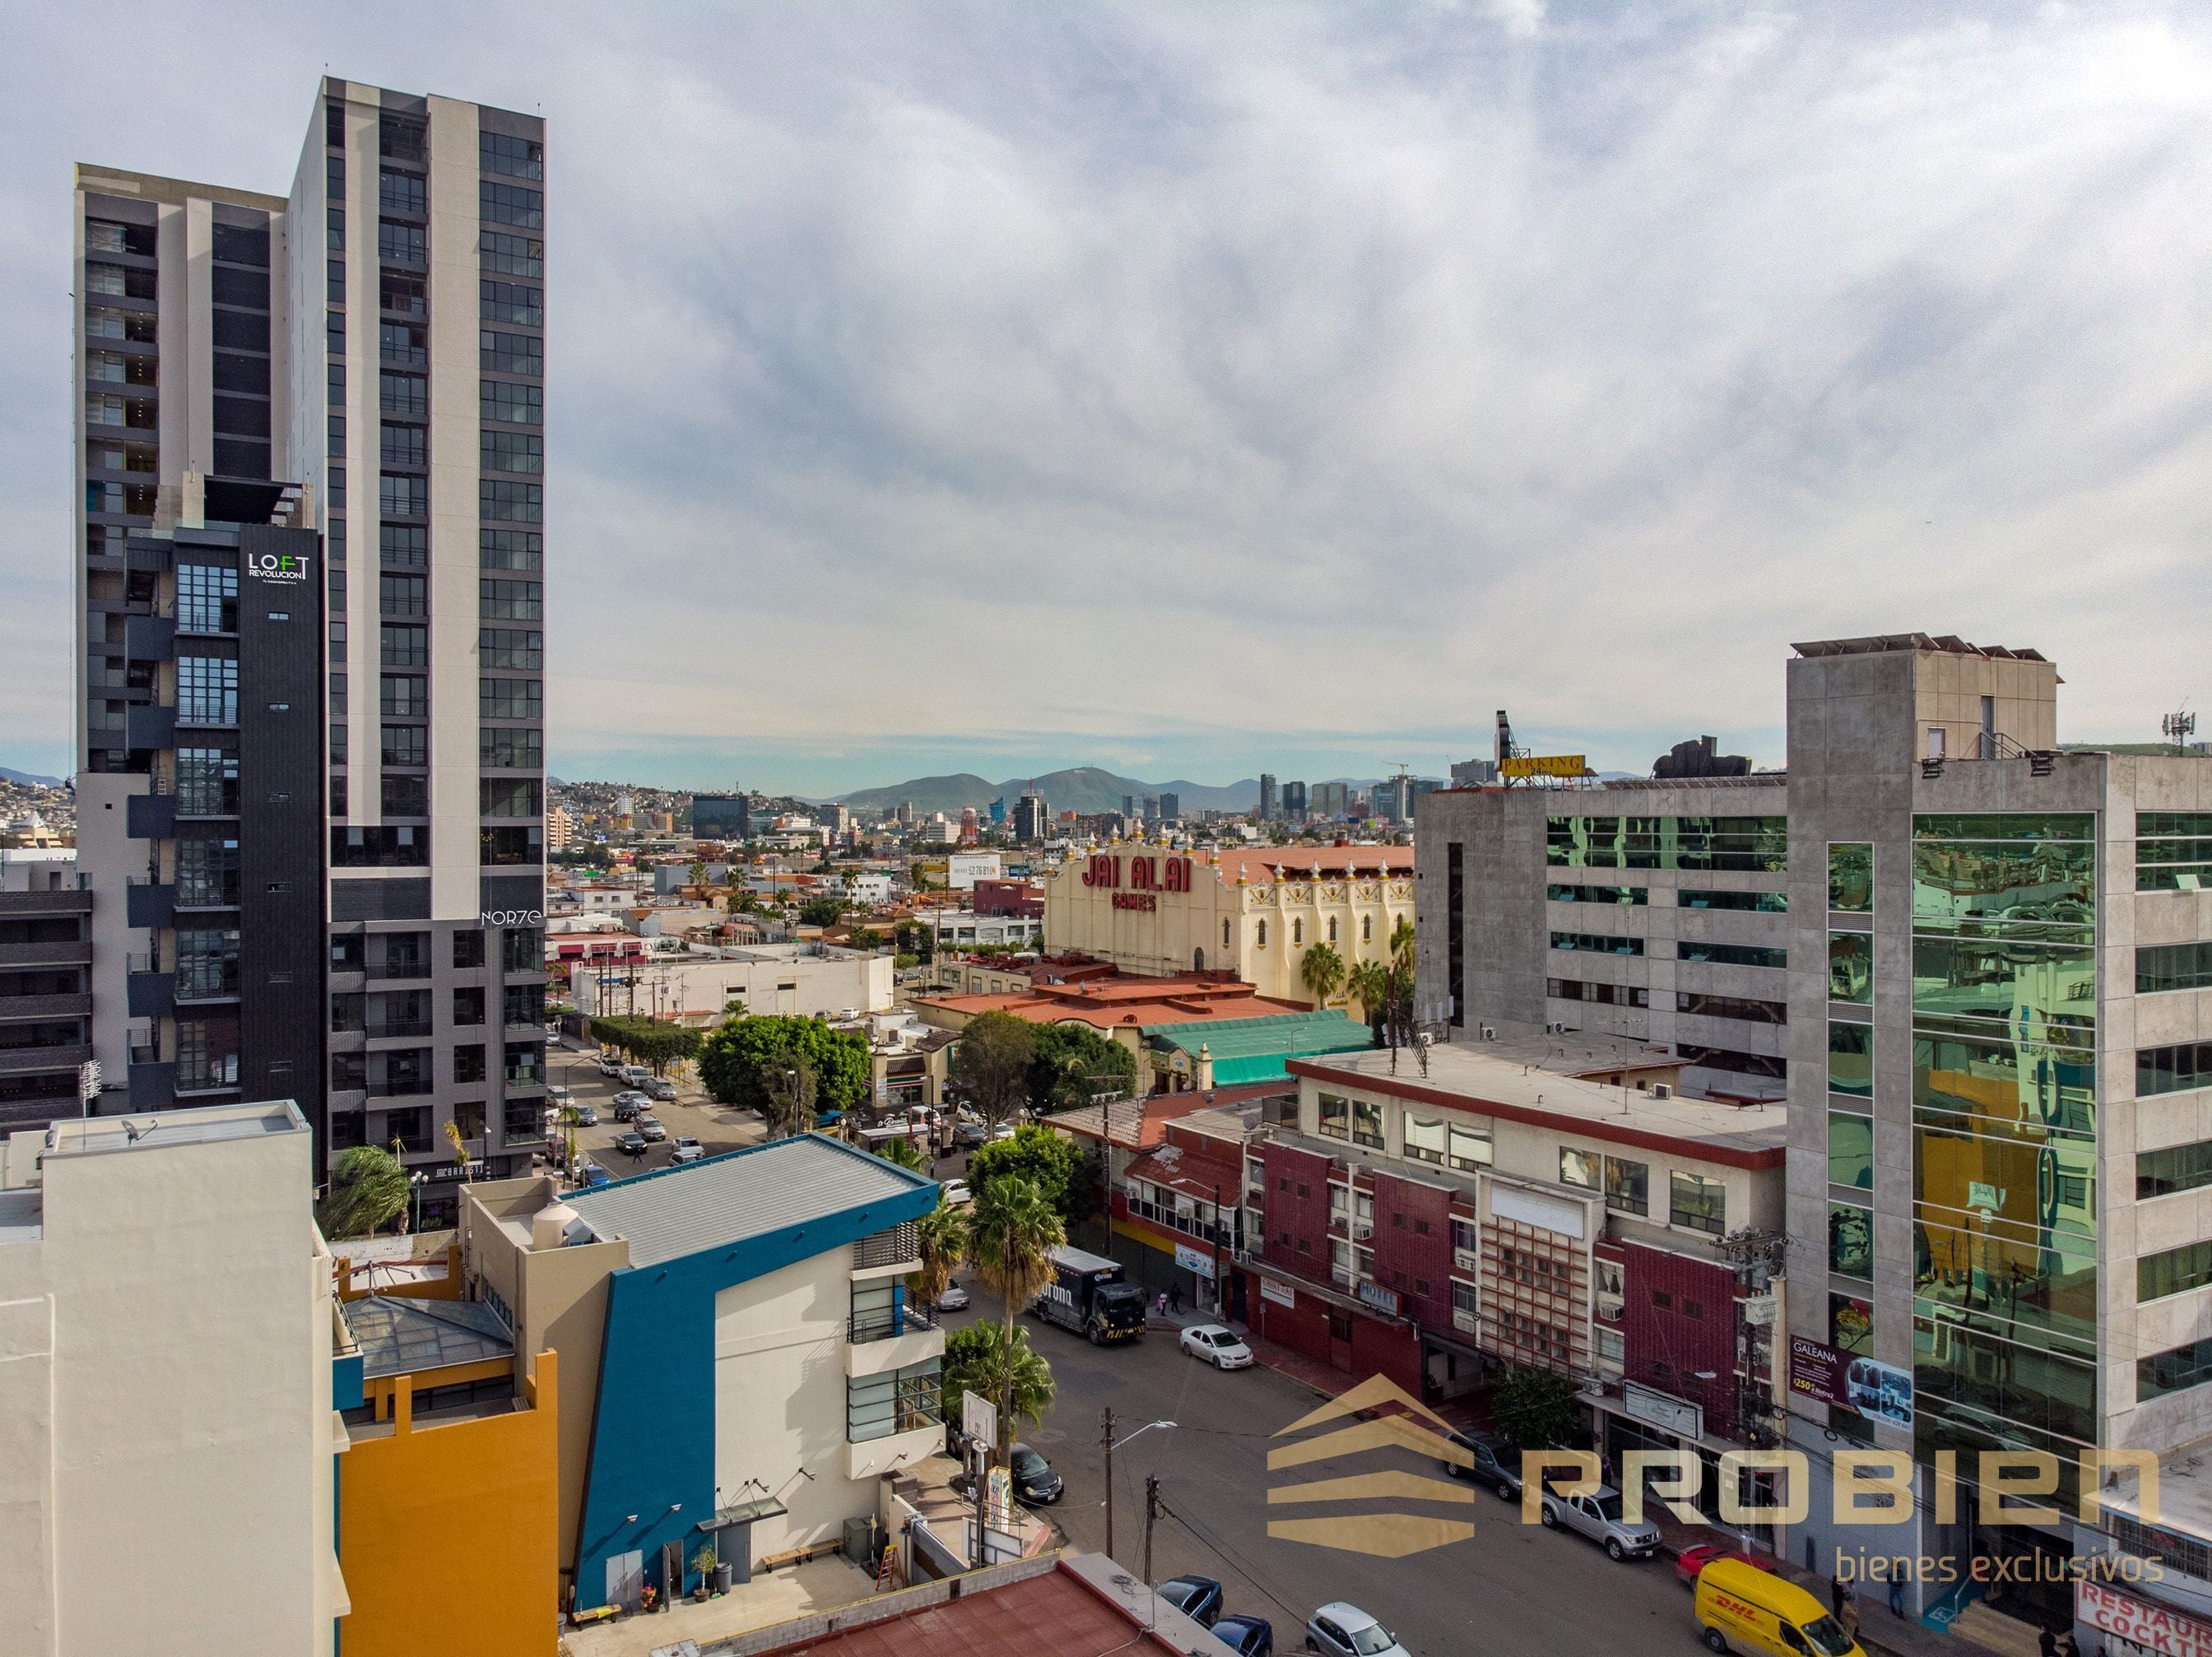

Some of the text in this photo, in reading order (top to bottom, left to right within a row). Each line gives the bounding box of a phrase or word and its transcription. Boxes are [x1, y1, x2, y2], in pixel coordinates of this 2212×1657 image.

[249, 553, 309, 579] LOFT
[249, 569, 302, 579] REVOLUCION
[1504, 755, 1580, 772] PARKING
[1081, 855, 1191, 893] JAI ALAI
[1111, 892, 1156, 912] GAMES
[1040, 1281, 1073, 1307] orona
[1794, 1342, 1837, 1364] GALEANA
[1715, 1594, 1756, 1622] DHL
